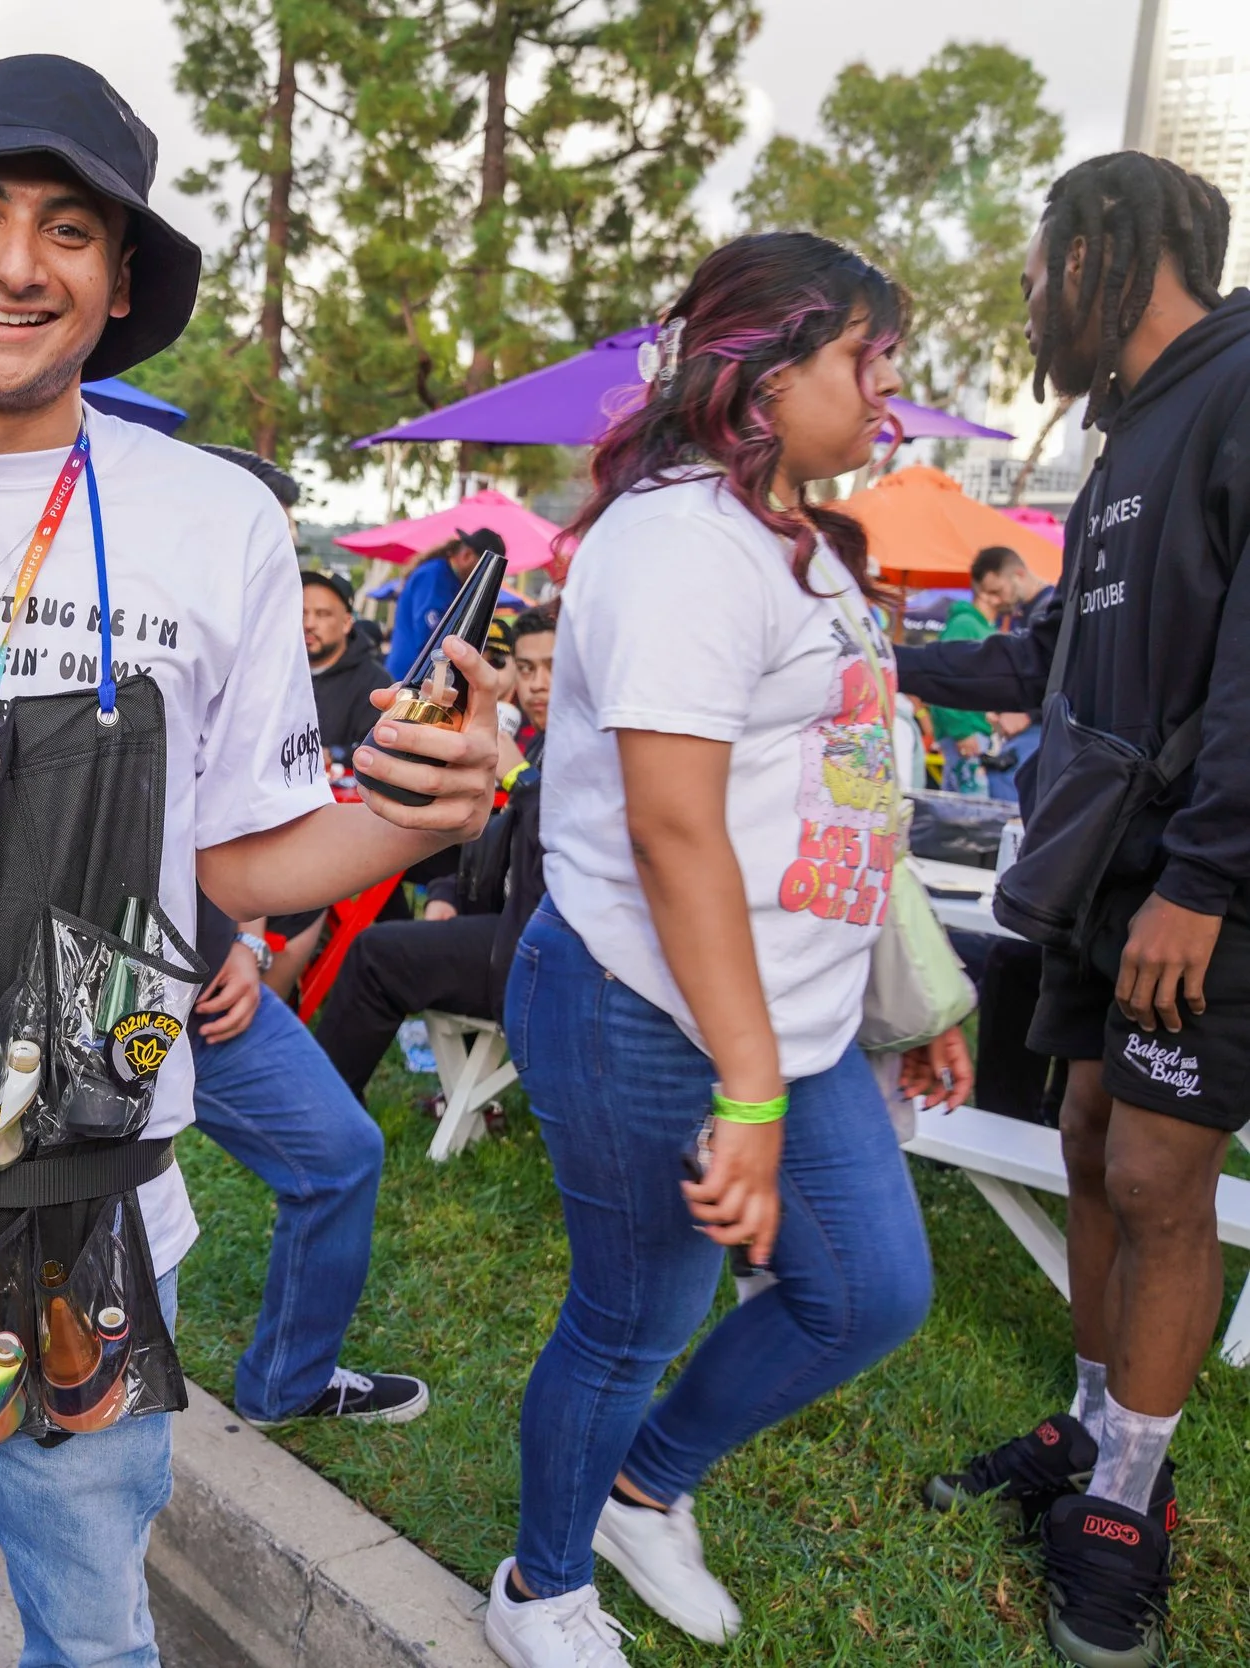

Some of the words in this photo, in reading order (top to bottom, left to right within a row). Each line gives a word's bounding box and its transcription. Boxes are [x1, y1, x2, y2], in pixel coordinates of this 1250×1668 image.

[49, 475, 72, 518] PUFFCO
[21, 544, 43, 588] PUFFCO
[25, 596, 76, 628] BUG
[86, 604, 126, 637] ME
[136, 613, 179, 650] I'M
[58, 651, 98, 684] ON
[1125, 1033, 1181, 1067] Baked
[1150, 1060, 1202, 1098] Busy
[1083, 1515, 1122, 1541] DVS
